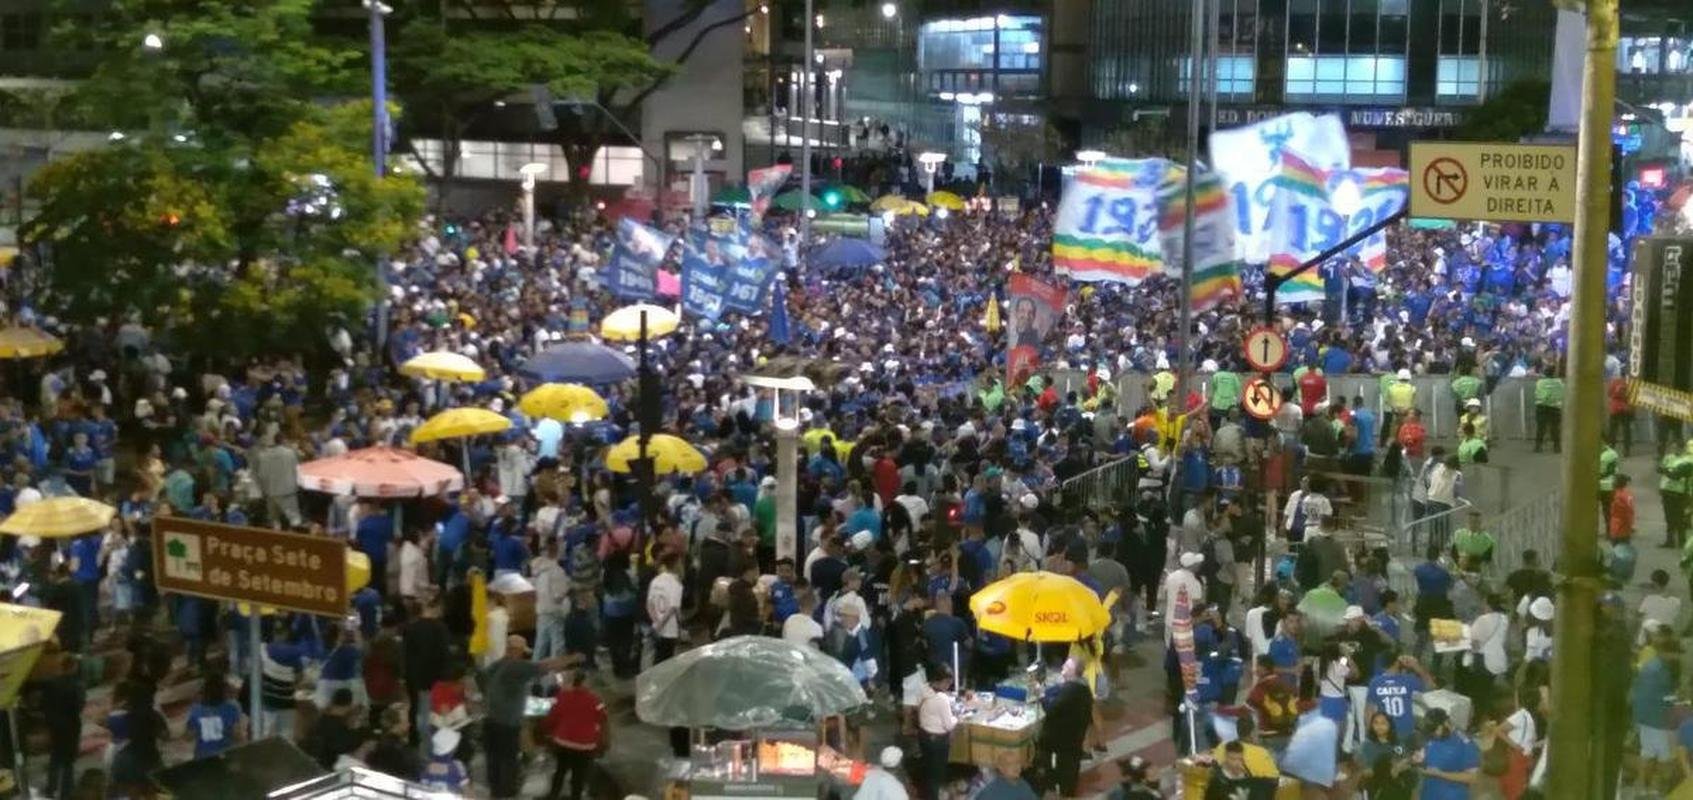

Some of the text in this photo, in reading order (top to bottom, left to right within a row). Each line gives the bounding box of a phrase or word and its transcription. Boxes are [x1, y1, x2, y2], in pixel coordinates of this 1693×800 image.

[1480, 152, 1565, 170] PROIBIDO
[1483, 176, 1538, 191] VIRAR
[1487, 197, 1555, 214] DIREITA
[206, 536, 321, 570] Praça Sete
[209, 567, 338, 601] de Setembro
[1034, 612, 1068, 623] SKOL
[1382, 696, 1404, 717] 10
